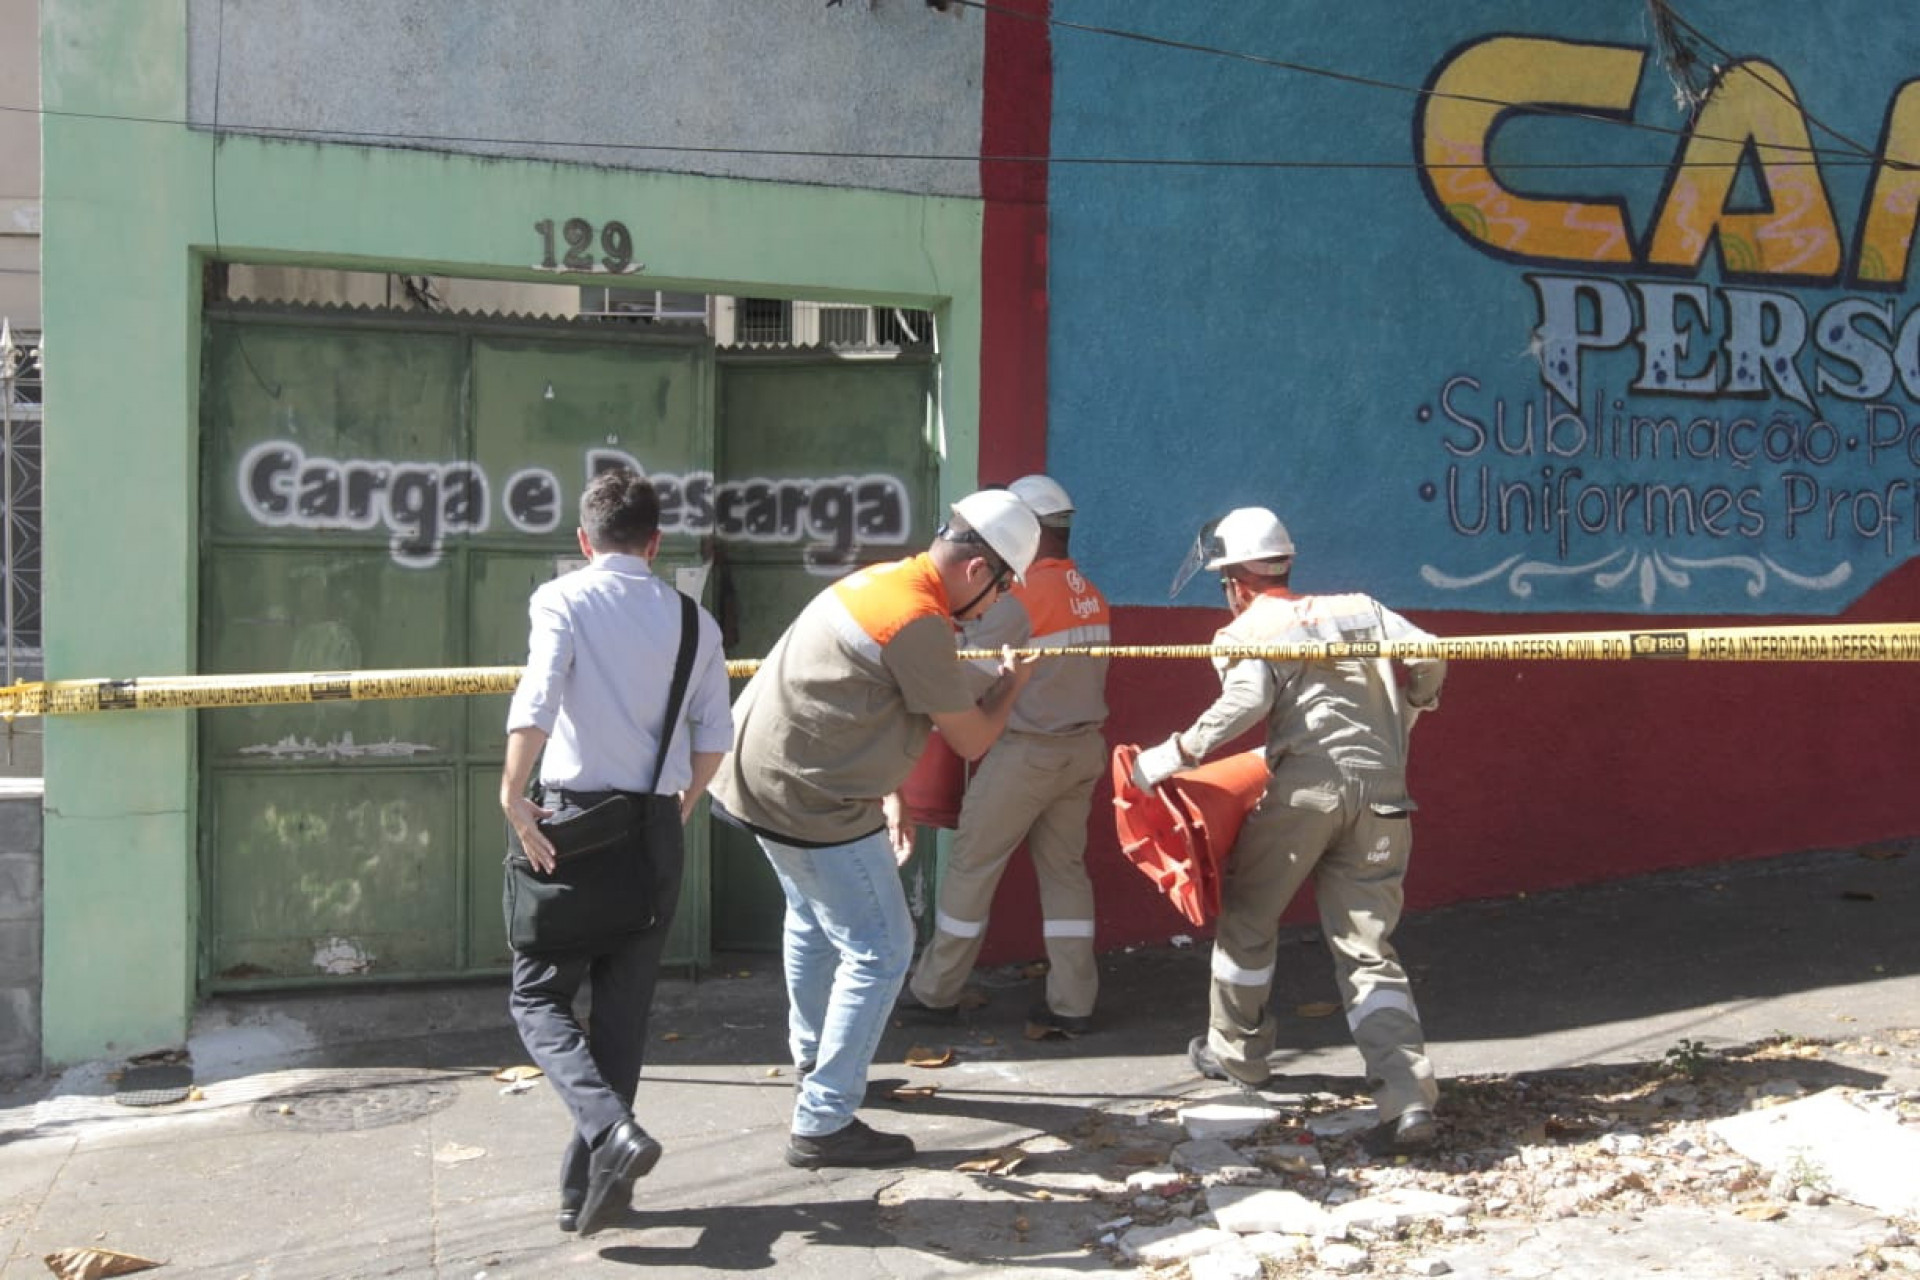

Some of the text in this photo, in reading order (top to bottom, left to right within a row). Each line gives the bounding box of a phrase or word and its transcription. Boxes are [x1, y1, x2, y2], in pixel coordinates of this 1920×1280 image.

[534, 216, 635, 270] 129
[1441, 375, 1841, 470] Sublimação
[239, 440, 490, 568] Carga
[503, 468, 562, 533] e
[1448, 464, 1766, 560] Uniformes
[1069, 597, 1101, 619] Light
[1426, 640, 1507, 660] INTERDITADA
[1512, 639, 1563, 660] DEFESA
[1566, 639, 1596, 660] CIVIL
[1602, 638, 1625, 659] RIO
[1659, 637, 1685, 650] RIO
[1739, 635, 1828, 660] INTERDITADA
[1832, 634, 1887, 660] DEFESA
